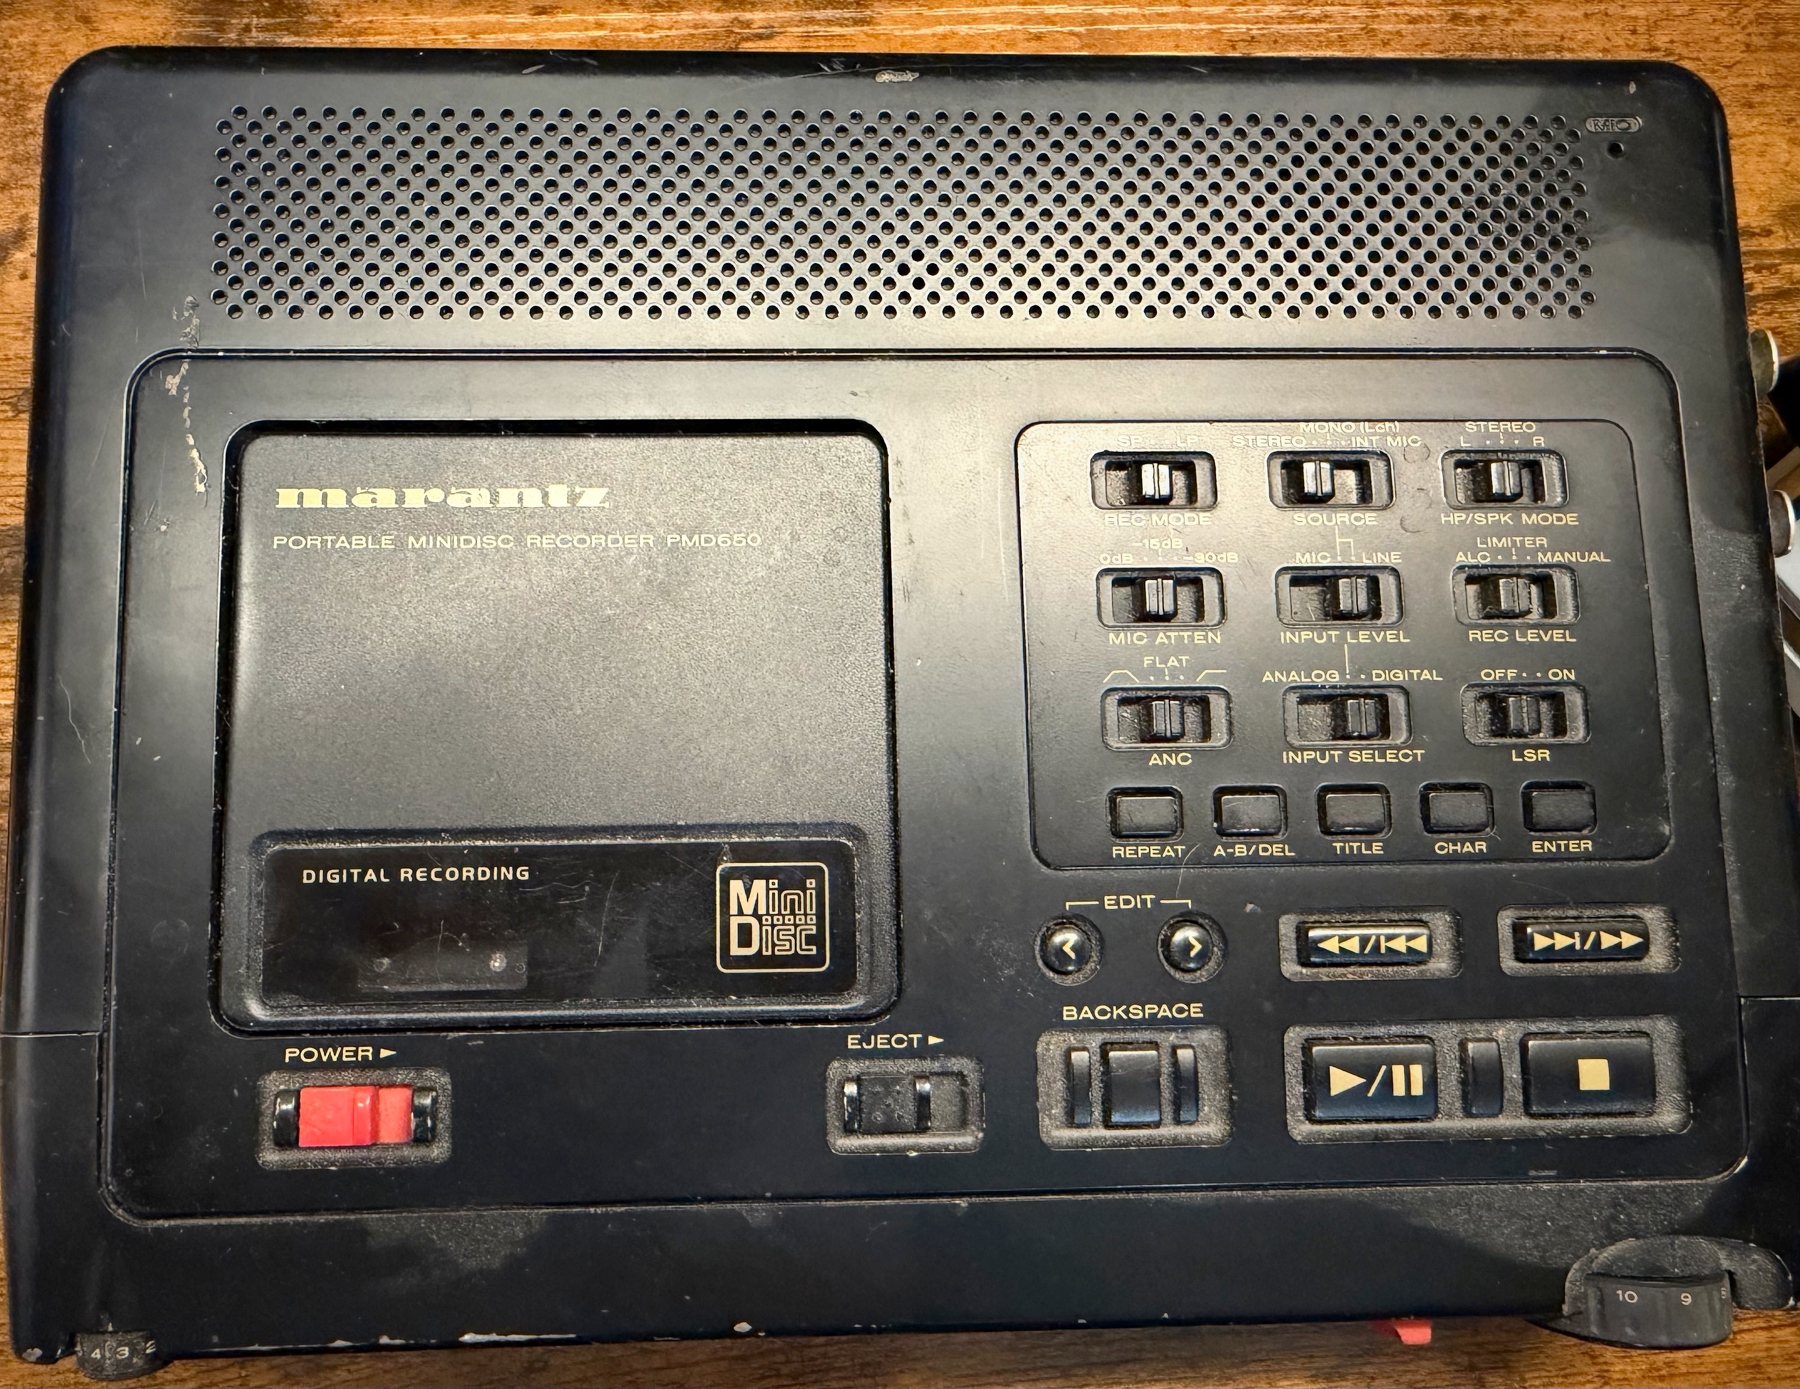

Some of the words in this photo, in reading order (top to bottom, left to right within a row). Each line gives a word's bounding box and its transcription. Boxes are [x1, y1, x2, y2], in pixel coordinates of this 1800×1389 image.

[1300, 422, 1356, 433] MONO
[1360, 421, 1400, 434] (Lch)
[1465, 421, 1536, 433] STEREO
[1117, 435, 1143, 447] SP
[1176, 435, 1199, 447] LP
[1233, 435, 1307, 447] STEREO
[1352, 436, 1379, 447] INT
[1386, 435, 1422, 447] MIC
[1460, 436, 1471, 447] L
[1533, 436, 1545, 447] R
[275, 484, 610, 509] marantz
[1104, 513, 1147, 526] REC
[1151, 512, 1213, 526] MODE
[1293, 512, 1379, 525] SOURCE
[1441, 512, 1514, 525] HP/SPK
[1521, 512, 1580, 525] MODE
[273, 534, 396, 550] PORTABLE
[407, 533, 515, 549] MINIDISC
[526, 533, 655, 549] RECORDER
[666, 532, 763, 548] PMD650
[1476, 536, 1548, 548] LIMITER
[1100, 553, 1134, 565] 0dB
[1295, 552, 1331, 563] MIC
[1362, 551, 1403, 563] LINE
[1455, 551, 1491, 563] ALC
[1537, 551, 1612, 563] MANUAL
[1108, 631, 1148, 645] MIC
[1155, 630, 1222, 645] ATTEN
[1280, 630, 1341, 644] INPUT
[1347, 630, 1411, 644] LEVEL
[1468, 630, 1509, 643] REC
[1515, 629, 1577, 643] LEVEL
[1143, 656, 1190, 668] FLAT
[1262, 670, 1340, 682] ANALOG
[1371, 669, 1444, 681] DIGITAL
[1481, 669, 1516, 681] OFF
[1547, 668, 1576, 681] ON
[1148, 753, 1193, 766] ANC
[1282, 750, 1344, 764] INPUT
[1348, 749, 1426, 763] SELECT
[1512, 749, 1552, 762] LSR
[1112, 845, 1185, 858] REPEAT
[1212, 844, 1296, 857] A-B/DEL
[1332, 842, 1384, 855] TITLE
[1434, 841, 1488, 854] CHAR
[1531, 839, 1593, 853] ENTER
[302, 867, 391, 884] DIGITAL
[399, 866, 531, 882] RECORDING
[729, 878, 817, 915] Mini
[1103, 894, 1157, 910] EDIT
[729, 915, 817, 956] Disc
[1062, 1003, 1205, 1021] BACKSPACE
[847, 1033, 923, 1049] EJECT
[284, 1046, 374, 1063] POWER
[1616, 1289, 1639, 1304] 10
[1680, 1292, 1693, 1306] 9
[90, 1348, 102, 1360] 4
[115, 1346, 130, 1360] 3
